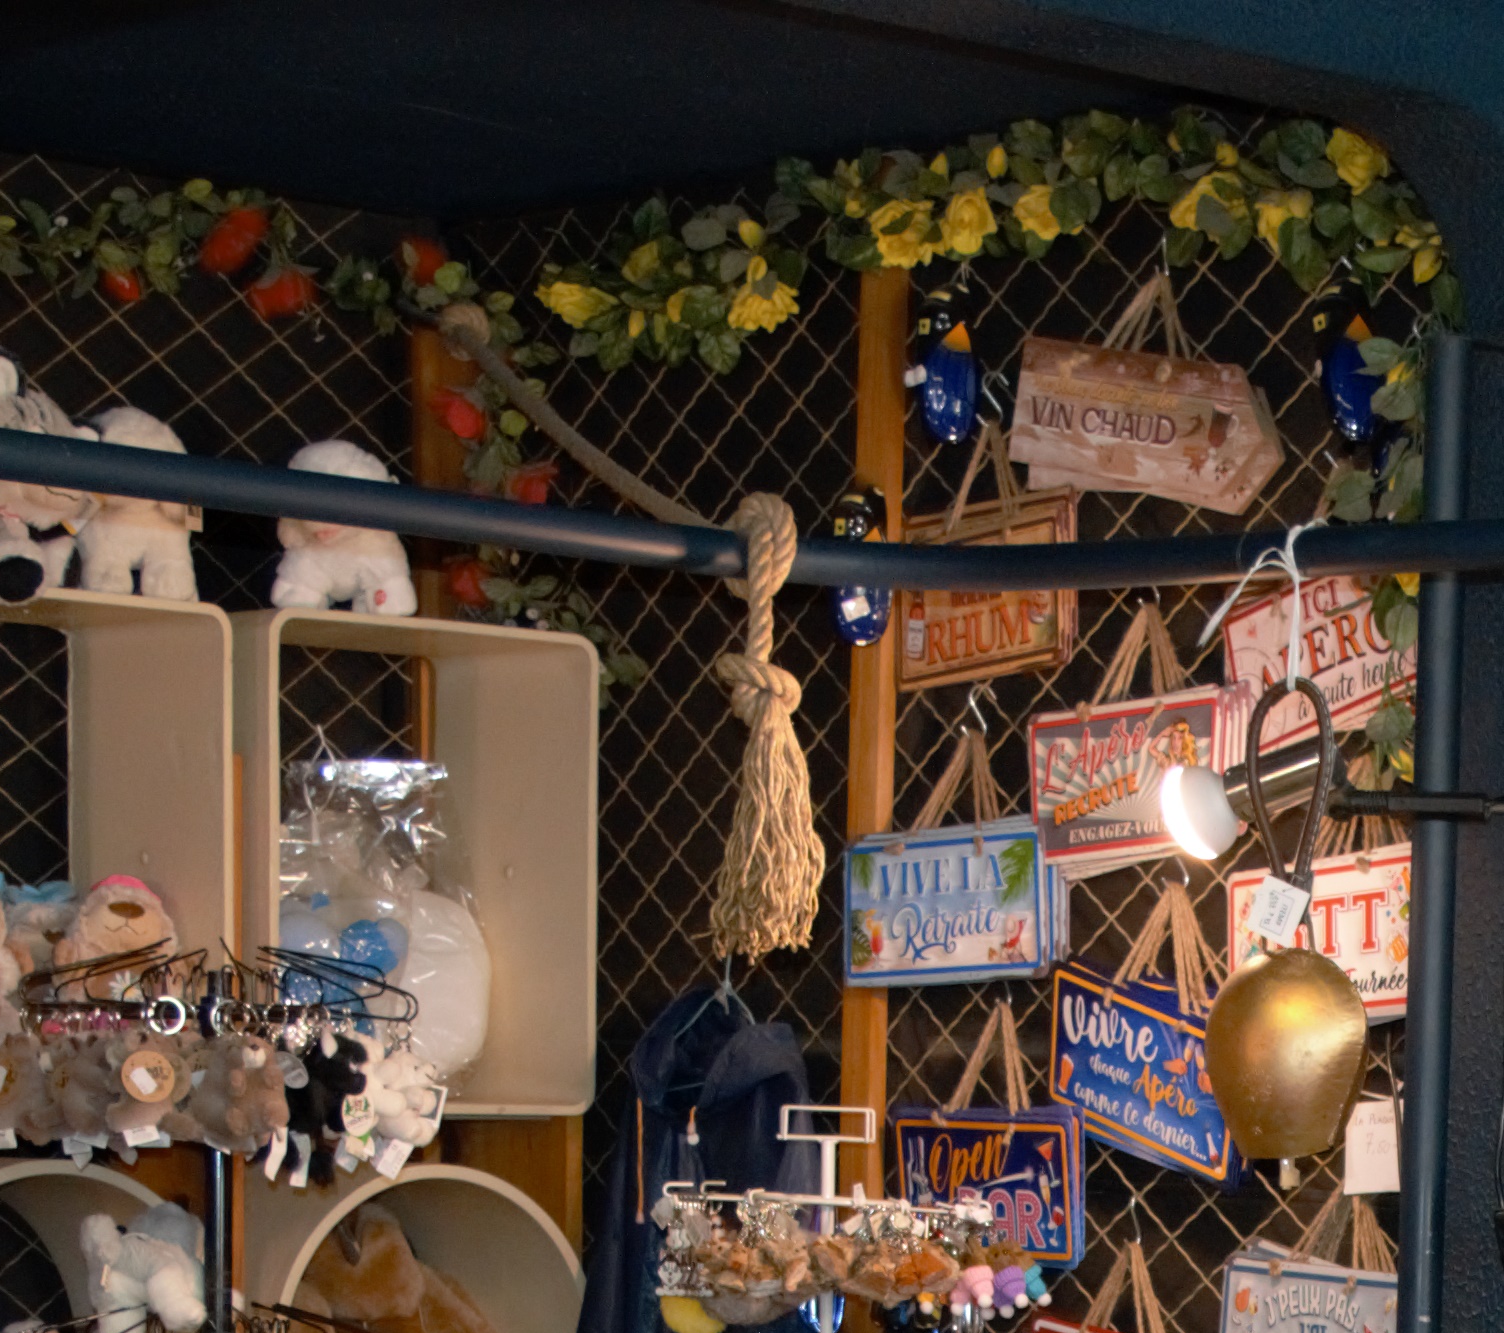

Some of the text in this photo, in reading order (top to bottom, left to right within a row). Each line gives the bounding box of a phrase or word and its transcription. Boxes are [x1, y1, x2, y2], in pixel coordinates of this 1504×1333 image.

[1031, 395, 1176, 445] VIN CHAUD
[923, 603, 1033, 667] RHUM
[1041, 716, 1150, 795] L'Apéro
[1052, 773, 1142, 827] RECRUTE
[879, 853, 1004, 899] VIVE LA
[890, 903, 999, 961] Retraite
[1061, 992, 1159, 1064] Vivre
[1072, 1079, 1121, 1120] comme
[1089, 1052, 1202, 1117] chaque Apéro
[927, 1124, 1010, 1194] Open
